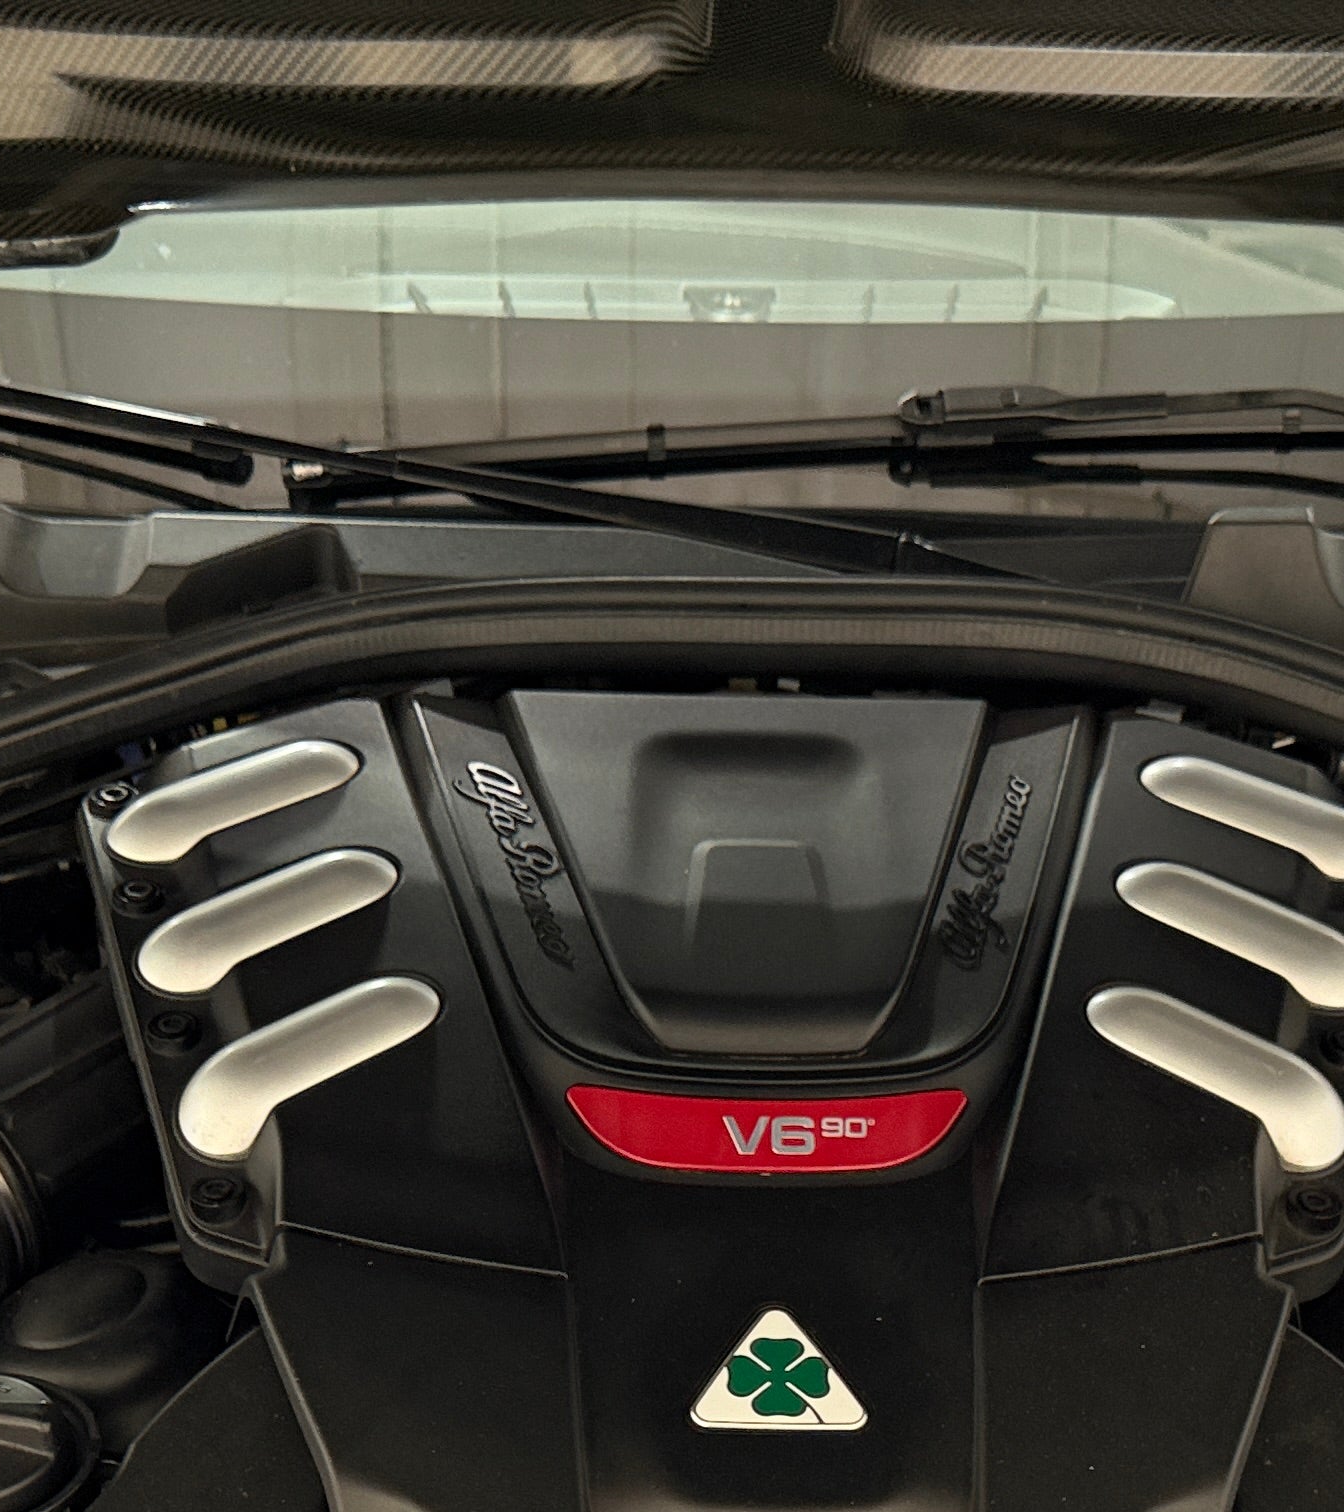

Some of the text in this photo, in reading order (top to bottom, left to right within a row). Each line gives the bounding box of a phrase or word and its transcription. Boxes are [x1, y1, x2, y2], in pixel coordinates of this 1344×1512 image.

[453, 761, 575, 970] Alfa Romeo
[938, 774, 1033, 971] Alfa Romeo
[722, 1115, 816, 1156] V6
